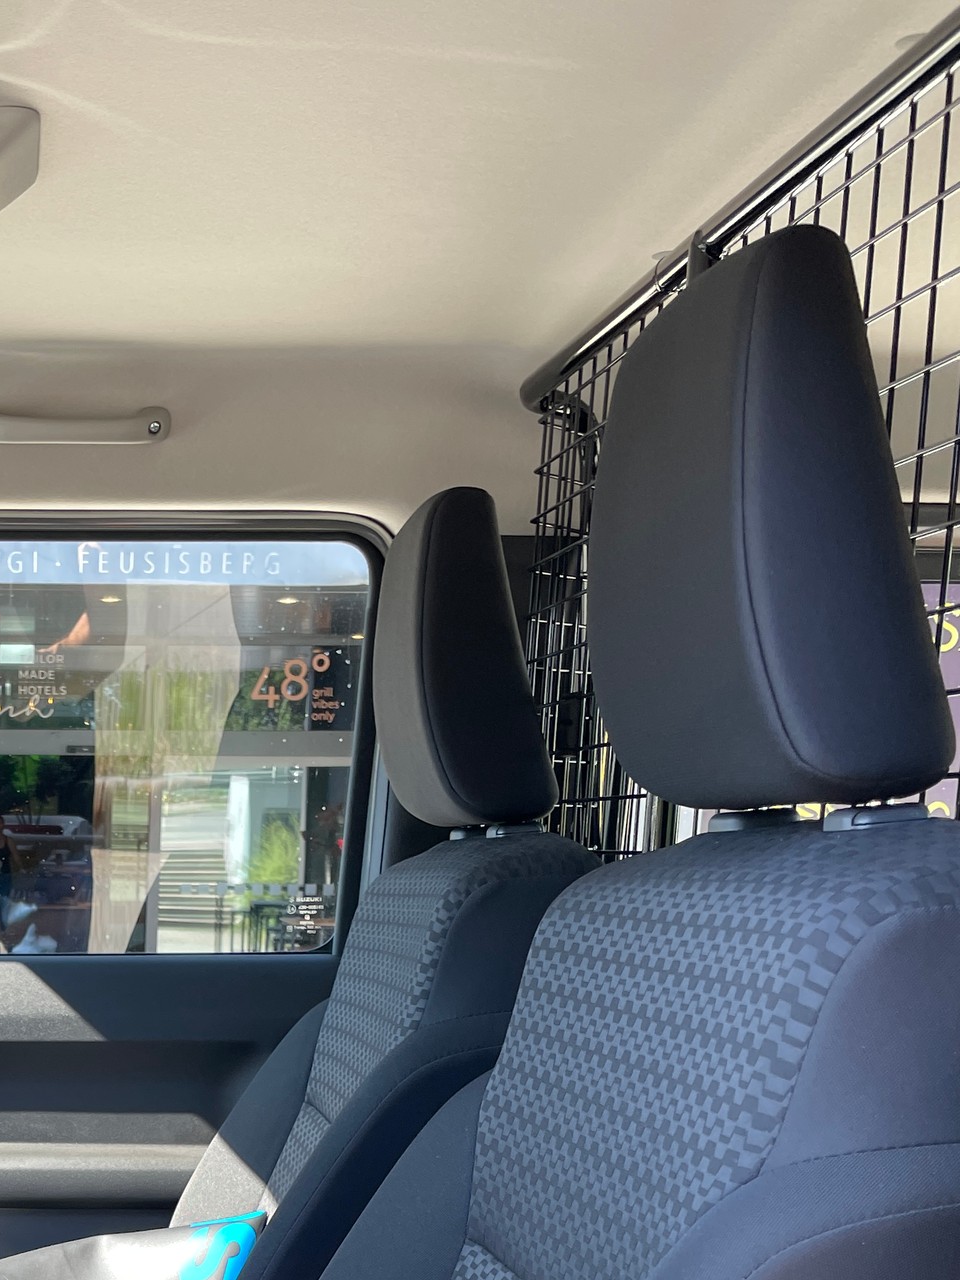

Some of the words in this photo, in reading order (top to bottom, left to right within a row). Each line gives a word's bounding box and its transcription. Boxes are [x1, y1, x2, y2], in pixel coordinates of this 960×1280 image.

[78, 551, 281, 575] FEUSISBERG
[19, 654, 64, 664] ILOR
[18, 670, 55, 680] MADE
[18, 685, 67, 696] HOTELS
[312, 687, 333, 699] grill
[312, 700, 339, 709] vibes
[311, 711, 335, 723] only
